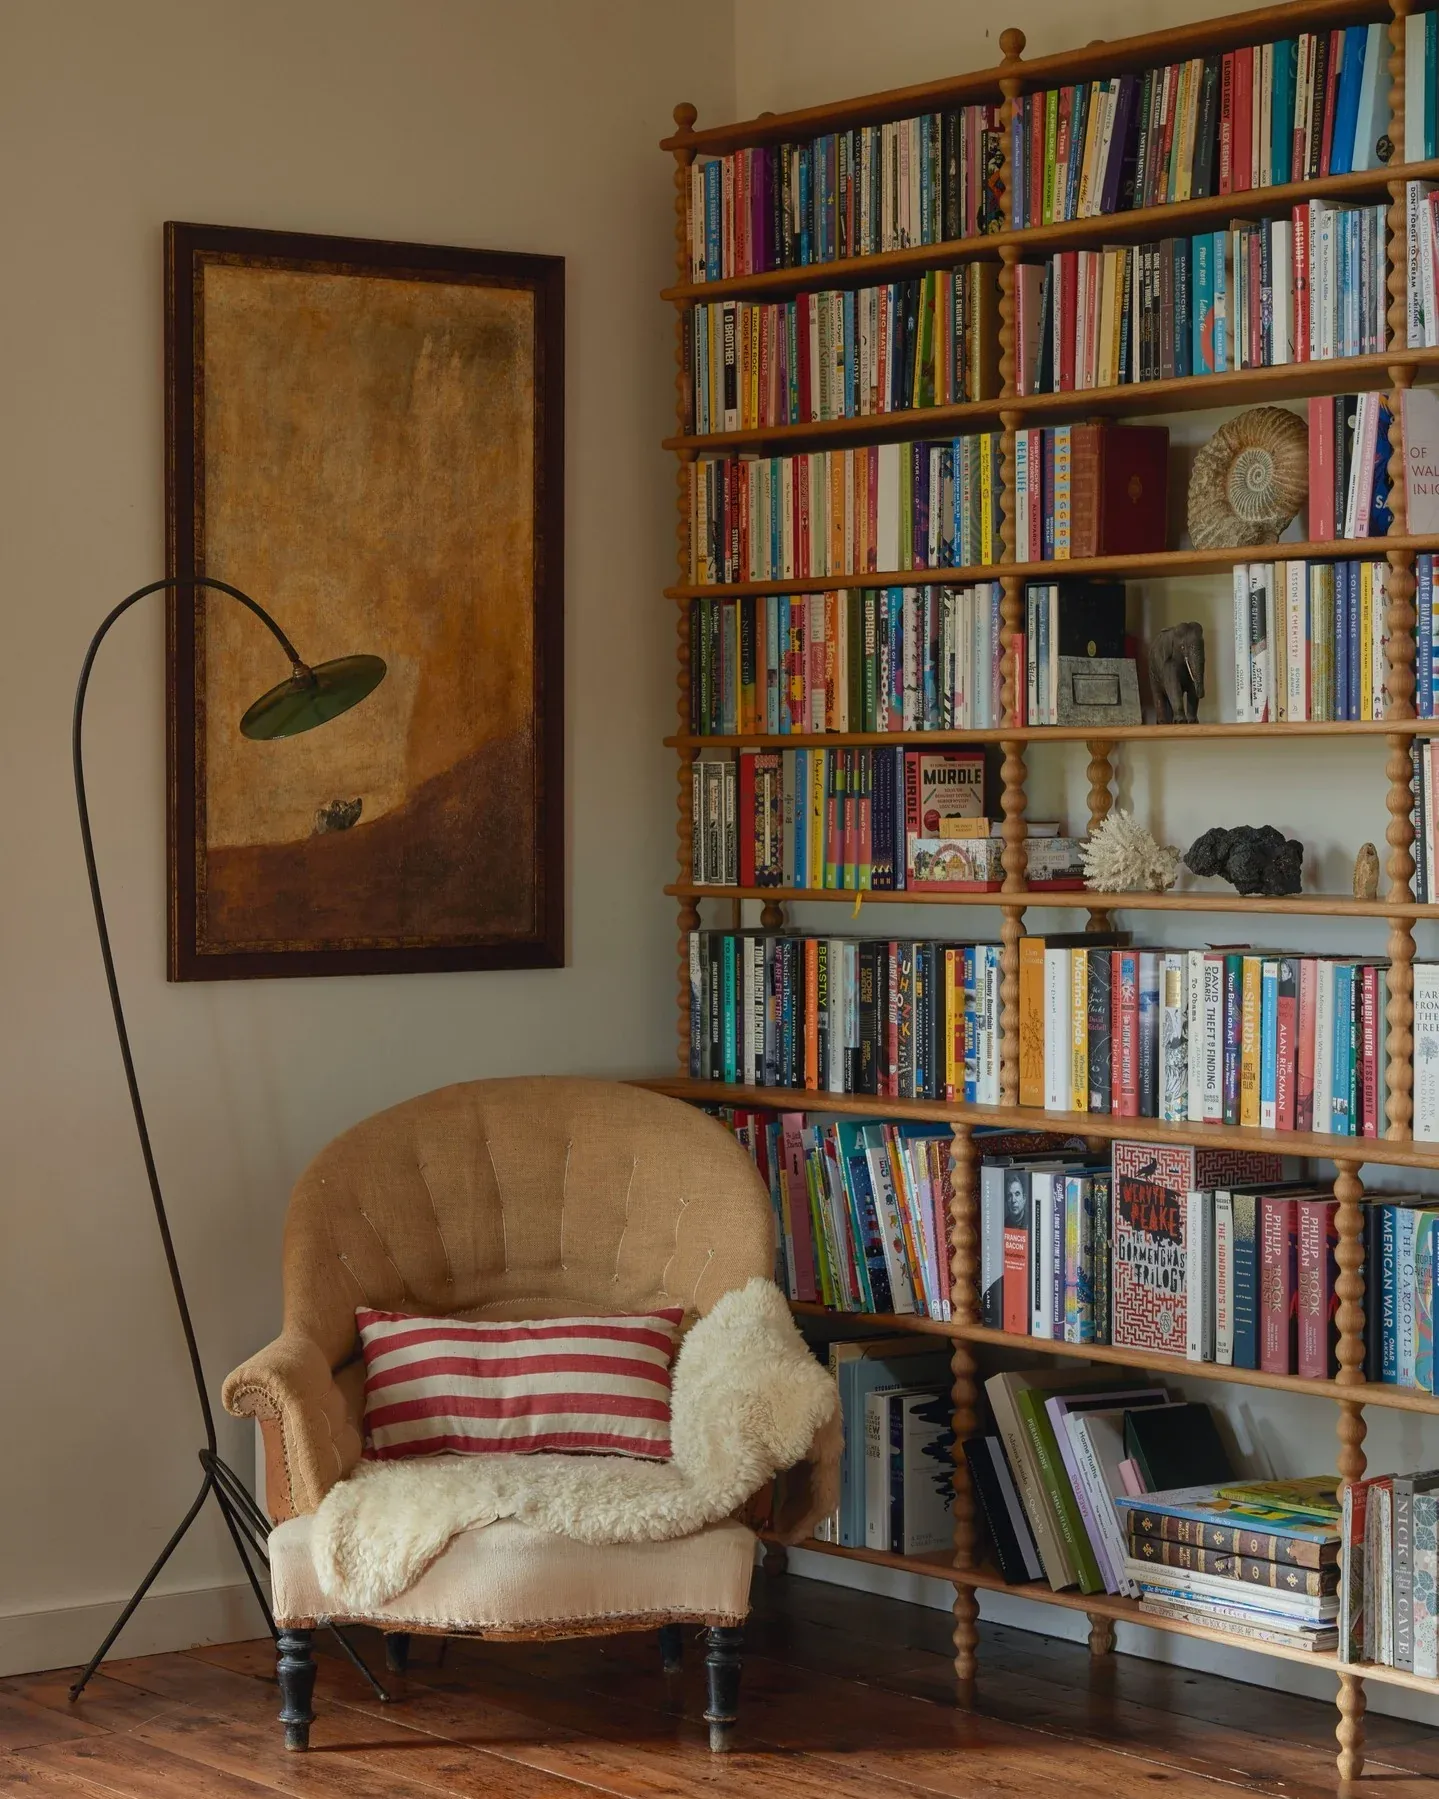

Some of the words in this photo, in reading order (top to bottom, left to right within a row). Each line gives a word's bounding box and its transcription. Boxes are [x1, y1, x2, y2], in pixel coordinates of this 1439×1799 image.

[1224, 60, 1234, 86] BLOOD
[1224, 89, 1233, 118] LEGACY
[1222, 122, 1232, 143] ALEX
[1136, 132, 1146, 188] INSTRUMENTAL
[1222, 145, 1232, 178] RENTON
[1296, 221, 1304, 260] QUESTION
[1410, 245, 1416, 254] TO
[818, 306, 828, 334] Song
[724, 324, 734, 366] BROTHER
[820, 338, 828, 349] of
[820, 352, 828, 402] Solomon
[1017, 442, 1027, 466] REAL
[1410, 447, 1428, 458] OF
[1017, 471, 1027, 492] LIFE
[1414, 484, 1426, 494] IN
[824, 594, 834, 640] Joseph
[866, 600, 874, 656] EUPHORIA
[825, 640, 835, 680] Heller
[906, 760, 917, 826] MURDLE
[923, 768, 982, 786] MURDLE
[1414, 796, 1420, 806] TO
[754, 945, 764, 964] TOM
[776, 945, 782, 960] WE
[754, 966, 764, 1003] WRIGHT
[818, 946, 826, 1006] BEASTLY
[1074, 956, 1084, 1008] Marina
[1192, 978, 1198, 990] To
[1365, 975, 1373, 990] THE
[976, 978, 985, 1014] Kitchen
[1088, 1006, 1106, 1014] Clocks
[1089, 995, 1104, 1005] Bone
[1365, 994, 1373, 1024] RABBIT
[1420, 990, 1439, 999] FAR
[754, 1005, 764, 1055] BLACKBIRD
[1072, 1010, 1084, 1046] Hyde
[1207, 1008, 1216, 1038] THEFT
[1228, 1018, 1234, 1028] on
[1244, 992, 1254, 1054] SHARDS
[1418, 1012, 1438, 1021] THE
[1365, 1028, 1373, 1056] HUTCH
[1207, 1049, 1216, 1089] FINDING
[1278, 1058, 1286, 1110] RICKMAN
[1056, 1182, 1064, 1202] Billy
[1121, 1182, 1167, 1205] MERVYN
[1131, 1203, 1178, 1237] PEAKE
[1264, 1204, 1272, 1264] PULLMAN
[1273, 1214, 1282, 1256] PHILIP
[1302, 1206, 1310, 1266] PULLMAN
[1004, 1233, 1026, 1242] FRANCIS
[1006, 1242, 1024, 1250] BACON
[1132, 1232, 1144, 1245] THE
[1310, 1217, 1319, 1258] PHILIP
[1384, 1210, 1392, 1290] AMERICAN
[1402, 1224, 1414, 1257] THE
[1272, 1266, 1282, 1312] BOOK
[1310, 1271, 1320, 1316] BOOK
[1384, 1292, 1392, 1328] WAR
[1402, 1264, 1414, 1358] GARGOYLE
[1384, 1331, 1389, 1339] EL
[1006, 1432, 1022, 1460] Adriana
[1014, 1460, 1028, 1486] Lestido
[1027, 1418, 1048, 1470] PERMISSIONS
[1079, 1431, 1090, 1454] Home
[1086, 1454, 1098, 1478] Truths
[1070, 1474, 1088, 1518] MAESTRAS
[1050, 1490, 1062, 1514] EMMA
[1057, 1516, 1073, 1544] HARDY
[1398, 1500, 1408, 1557] NICK
[1156, 1586, 1176, 1596] Brunhoff
[1398, 1598, 1409, 1654] CAVE
